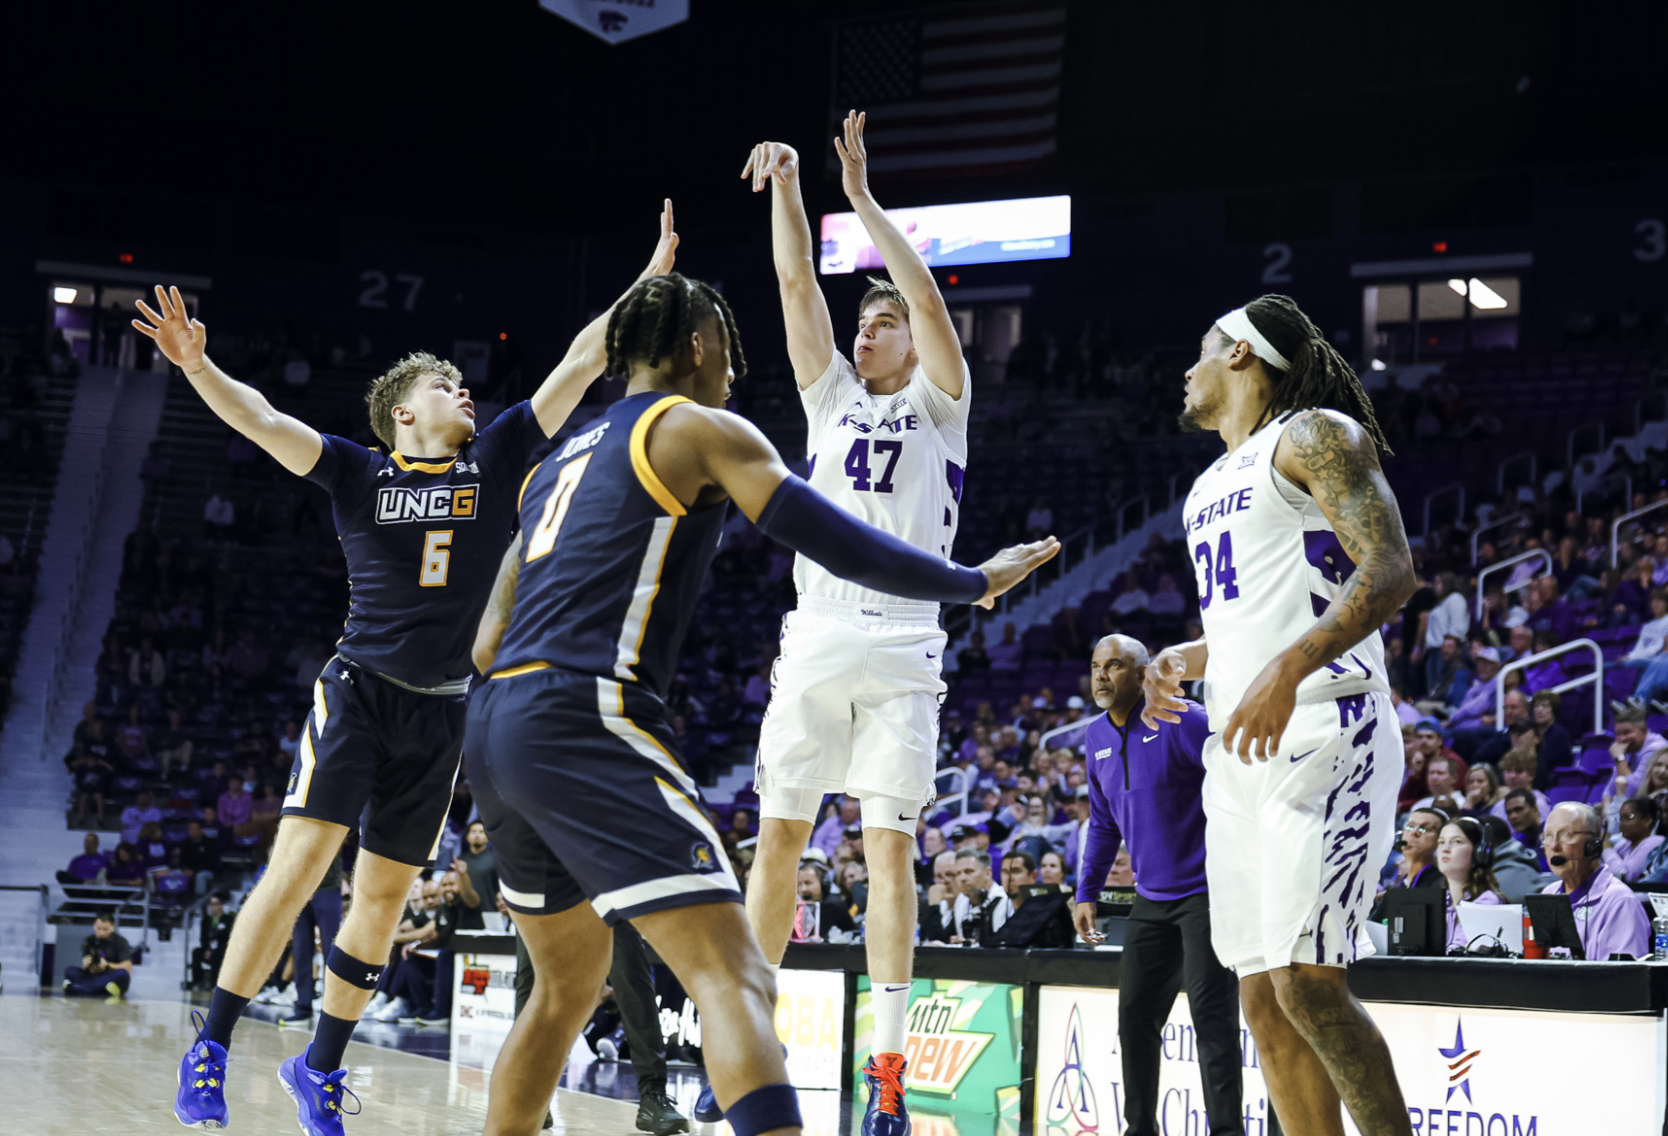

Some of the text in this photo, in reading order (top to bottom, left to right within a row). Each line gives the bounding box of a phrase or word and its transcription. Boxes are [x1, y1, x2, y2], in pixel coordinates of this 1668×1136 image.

[1262, 242, 1292, 284] 2
[1633, 218, 1667, 262] 3
[358, 269, 424, 312] 27
[844, 438, 903, 494] 47
[376, 484, 480, 524] UNCG
[526, 452, 593, 563] 0
[419, 530, 454, 587] 6
[1195, 530, 1240, 611] 34
[774, 992, 838, 1051] OBA
[1408, 1107, 1537, 1136] REEDOM
